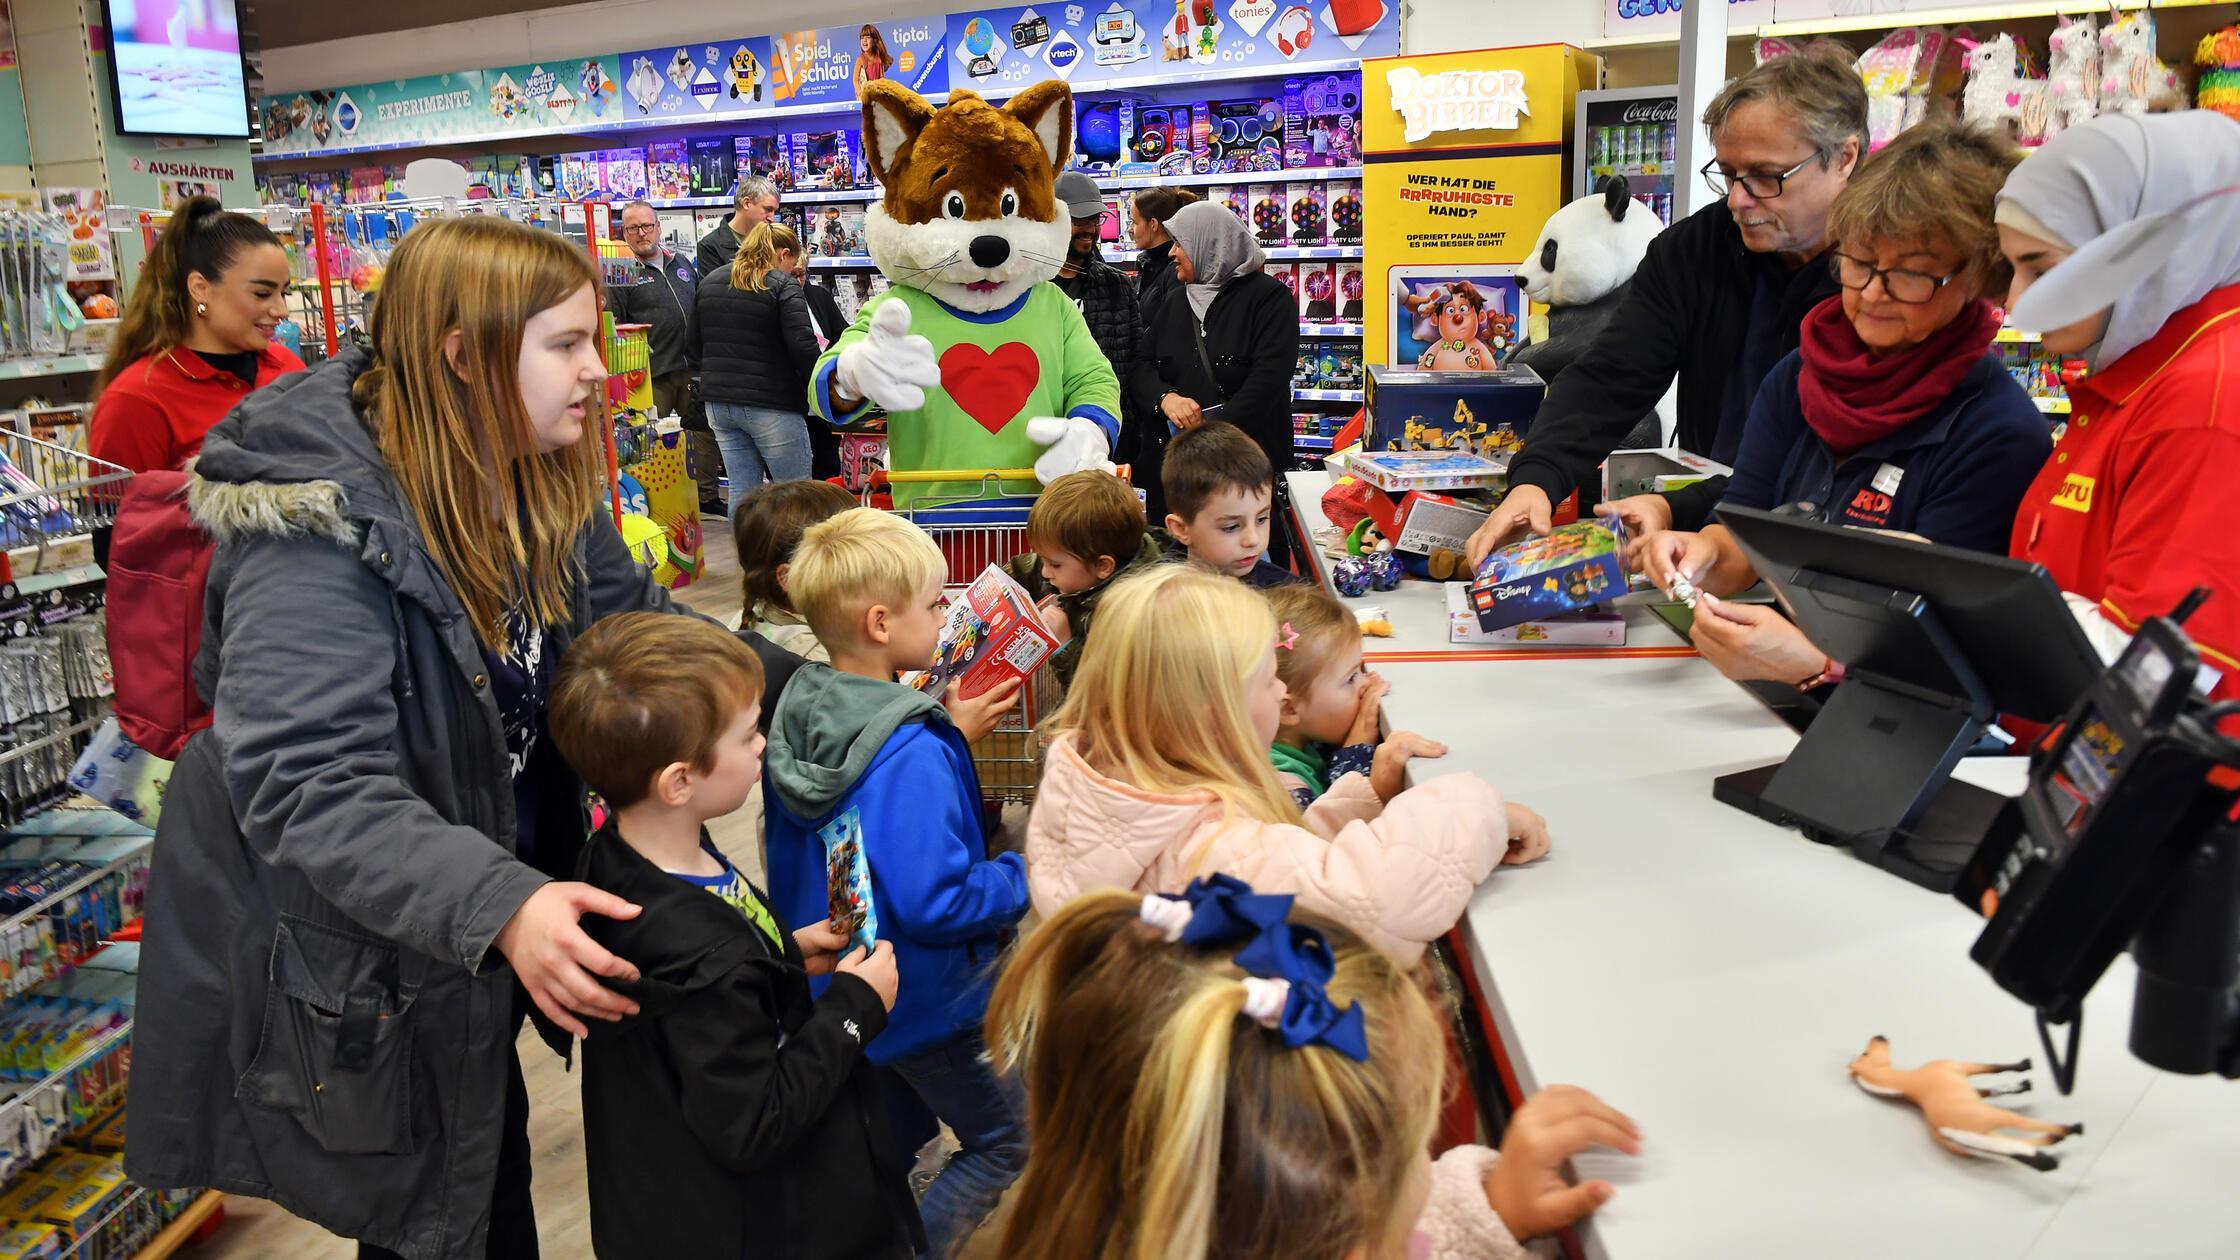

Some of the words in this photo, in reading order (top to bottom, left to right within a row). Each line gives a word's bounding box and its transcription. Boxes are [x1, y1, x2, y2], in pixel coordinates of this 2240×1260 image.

[1234, 6, 1270, 18] tonies
[893, 25, 928, 47] tiptoi
[795, 39, 831, 65] Spiel
[832, 51, 851, 64] dich
[1050, 48, 1076, 59] vtech
[800, 61, 849, 83] schlau
[912, 44, 944, 91] Ravensburger
[525, 82, 554, 98] GOOZLE
[1390, 69, 1524, 100] DOKTOR
[377, 90, 472, 120] EXPERIMENTE
[1405, 100, 1515, 136] BIBBER
[133, 159, 140, 171] 2
[148, 160, 234, 181] AUSHÄRTEN
[1408, 174, 1438, 186] WER
[1441, 177, 1469, 188] HAT
[1473, 179, 1496, 190] DIE
[1399, 188, 1514, 206] RRRRUHIGSTE
[1428, 205, 1477, 218] HAND?
[1406, 233, 1448, 241] OPERIERT
[1450, 232, 1476, 240] PAUL,
[1476, 239, 1503, 247] GEHT!
[1492, 583, 1532, 601] Disney
